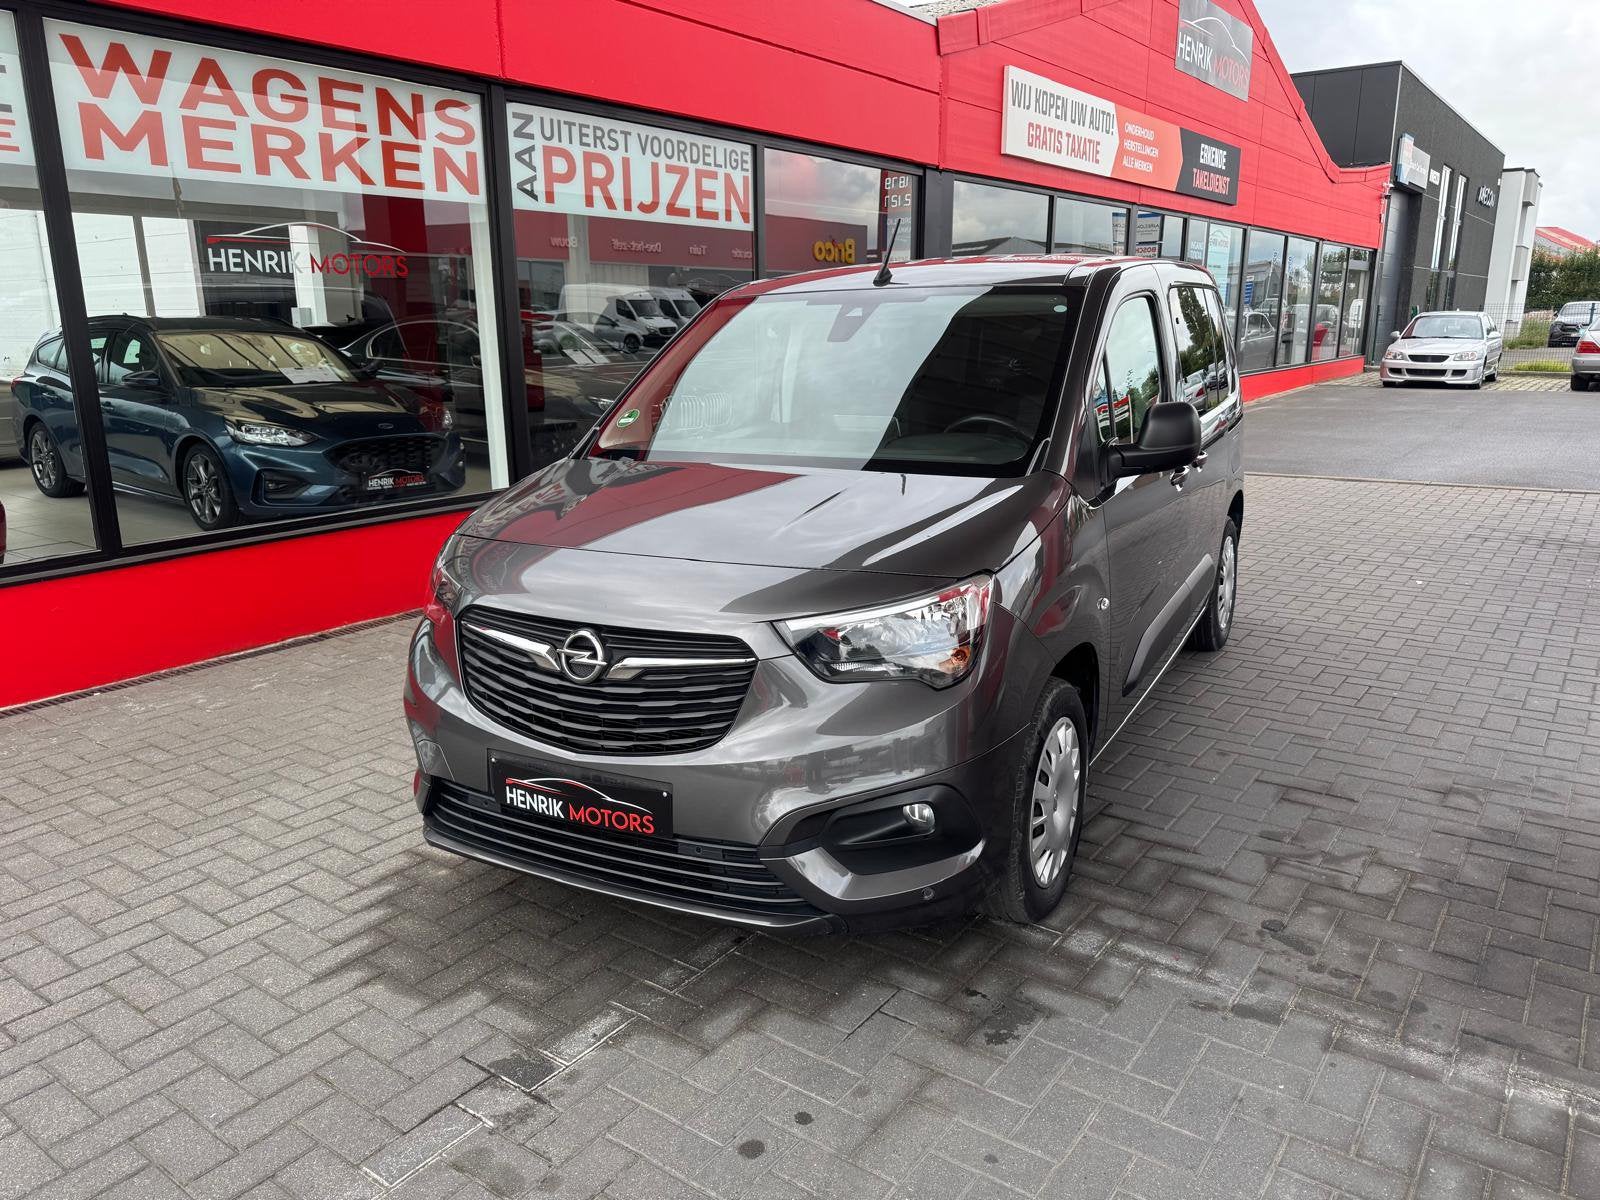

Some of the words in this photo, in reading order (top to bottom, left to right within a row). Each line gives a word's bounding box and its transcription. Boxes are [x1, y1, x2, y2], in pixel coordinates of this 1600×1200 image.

[1177, 31, 1213, 73] HENRIK
[1213, 55, 1249, 91] MOTORS
[59, 33, 476, 147] WAGENS
[1011, 79, 1031, 110] WIJ
[1034, 87, 1068, 122] KOPEN
[1070, 100, 1087, 127] UW
[1088, 106, 1115, 136] AUTO!
[78, 102, 480, 196] MERKEN
[540, 116, 632, 154] UITERST
[637, 132, 750, 172] VOORDELIGE
[1027, 121, 1062, 154] GRATIS
[1065, 131, 1101, 164] TAXATIE
[1124, 122, 1155, 141] ONDERHOUD
[512, 111, 538, 202] AAN
[1122, 155, 1135, 169] ALLE
[1134, 157, 1153, 173] MERKEN
[1199, 143, 1227, 170] ERKENDE
[541, 145, 751, 224] PRIJZEN
[1192, 167, 1231, 195] TAKELDIENST
[207, 248, 304, 274] HENRIK
[310, 252, 409, 277] MOTORS
[368, 477, 395, 487] HENRIK
[505, 786, 564, 819] HENRIK
[569, 803, 655, 834] MOTORS
